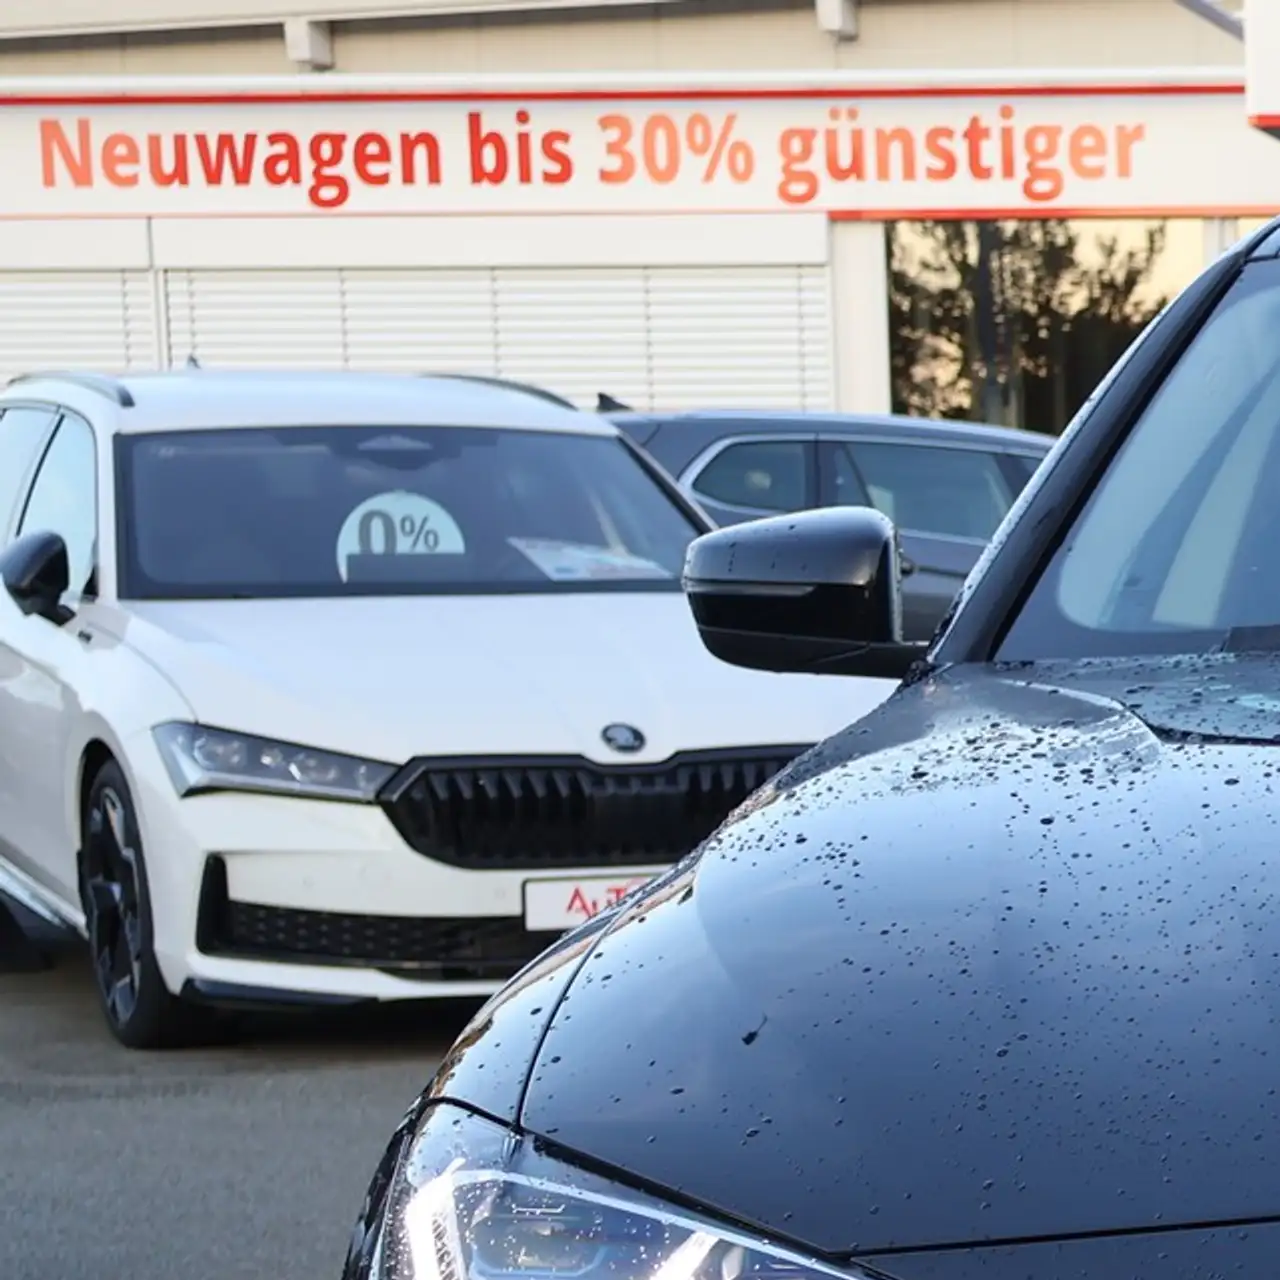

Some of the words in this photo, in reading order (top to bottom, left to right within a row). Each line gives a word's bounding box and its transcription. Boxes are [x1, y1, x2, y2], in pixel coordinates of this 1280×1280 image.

[37, 116, 443, 207] Neuwagen
[467, 109, 575, 187] bis
[596, 111, 756, 185] 30%
[776, 104, 1147, 204] günstiger
